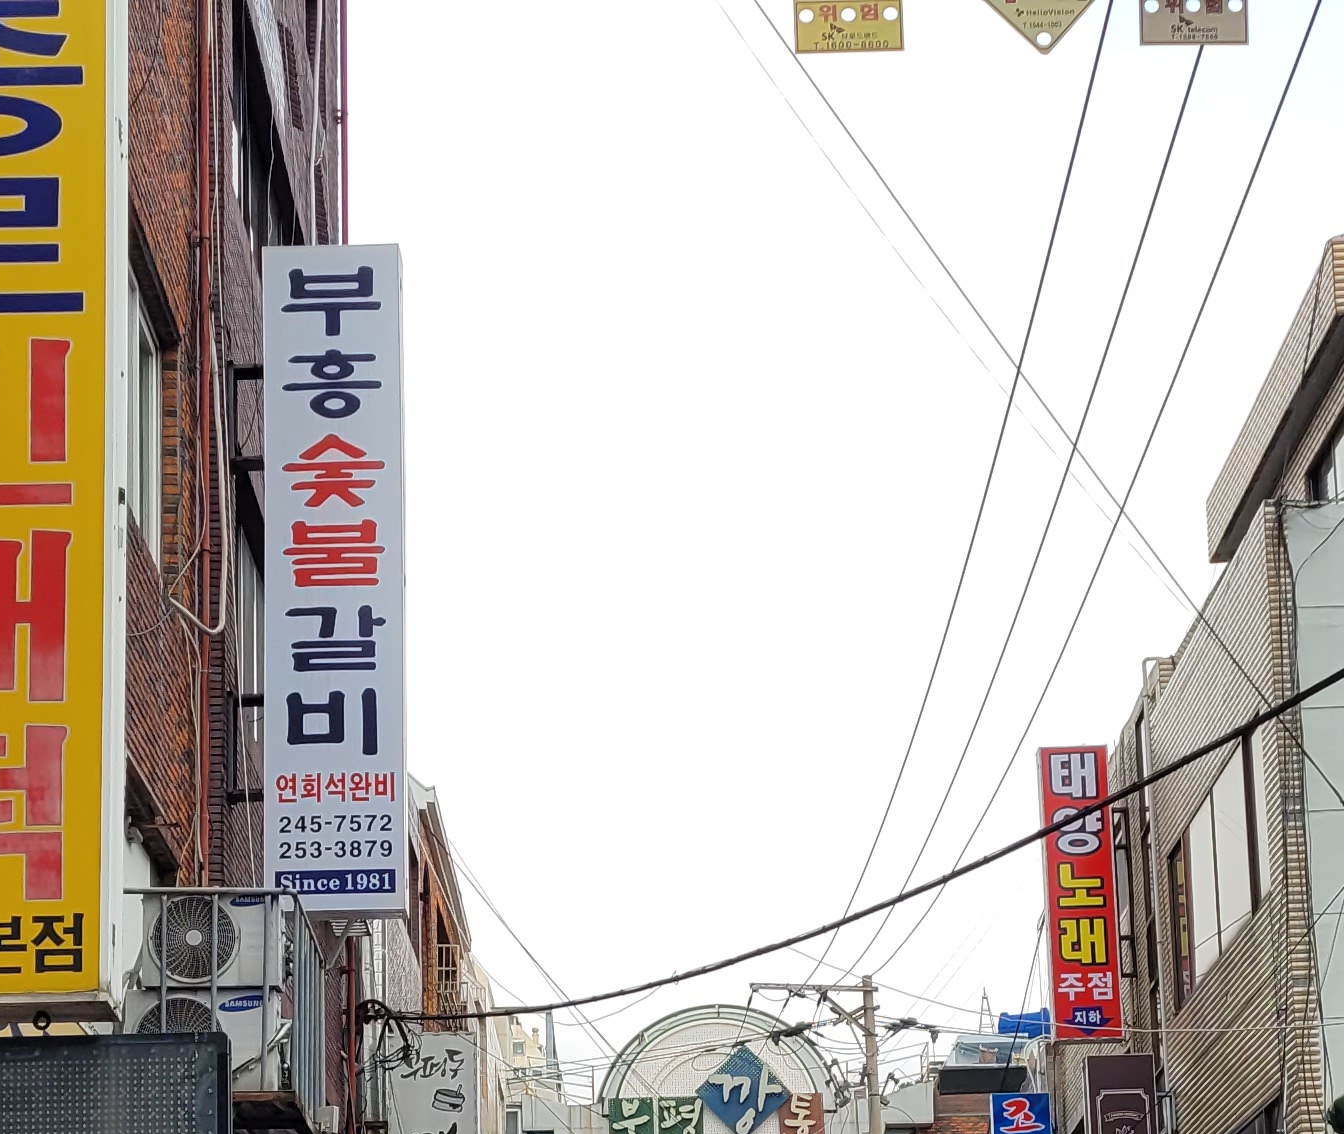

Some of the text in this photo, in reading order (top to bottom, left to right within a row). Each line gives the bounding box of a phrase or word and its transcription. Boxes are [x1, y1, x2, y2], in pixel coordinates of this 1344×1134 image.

[819, 3, 879, 23] 위험
[1026, 8, 1075, 16] HelloVision
[821, 32, 834, 41] SK
[1171, 25, 1218, 34] SK telecom
[275, 772, 397, 804] 연회석완비
[278, 812, 394, 834] 245-7572
[278, 839, 394, 860] 253-3879
[280, 872, 392, 892] Since 1981
[1058, 972, 1112, 1001] 주점
[1074, 1009, 1101, 1025] 지하
